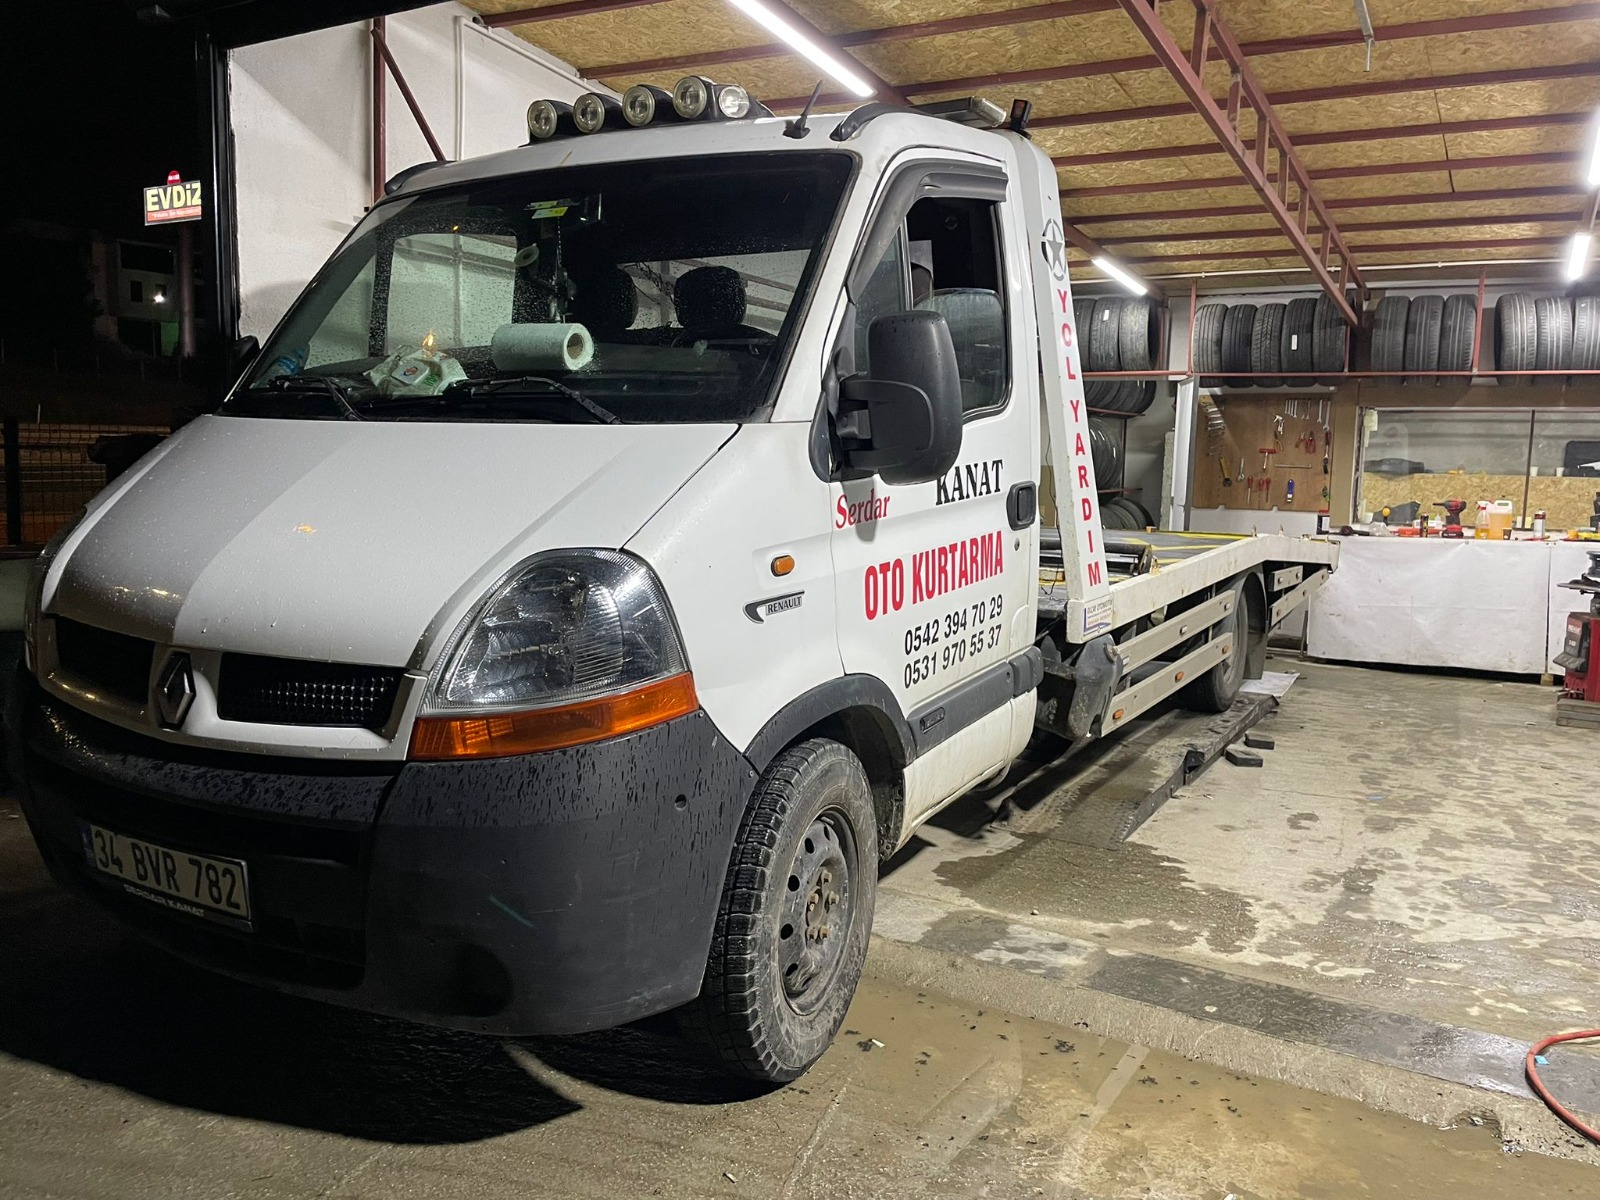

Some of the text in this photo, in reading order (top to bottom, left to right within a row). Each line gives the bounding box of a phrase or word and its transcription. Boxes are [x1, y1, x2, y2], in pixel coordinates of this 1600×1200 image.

[1057, 288, 1077, 380] YOL
[1069, 399, 1102, 587] YARDIM
[836, 488, 890, 529] Serdar
[935, 458, 1004, 506] KANAT
[767, 596, 802, 614] RENAULT
[864, 530, 1004, 620] OTO KURTARMA
[905, 593, 1003, 655] 0542 394 70 29
[904, 624, 1001, 688] 0531 970 55 37
[95, 830, 241, 910] 34 BVR 782
